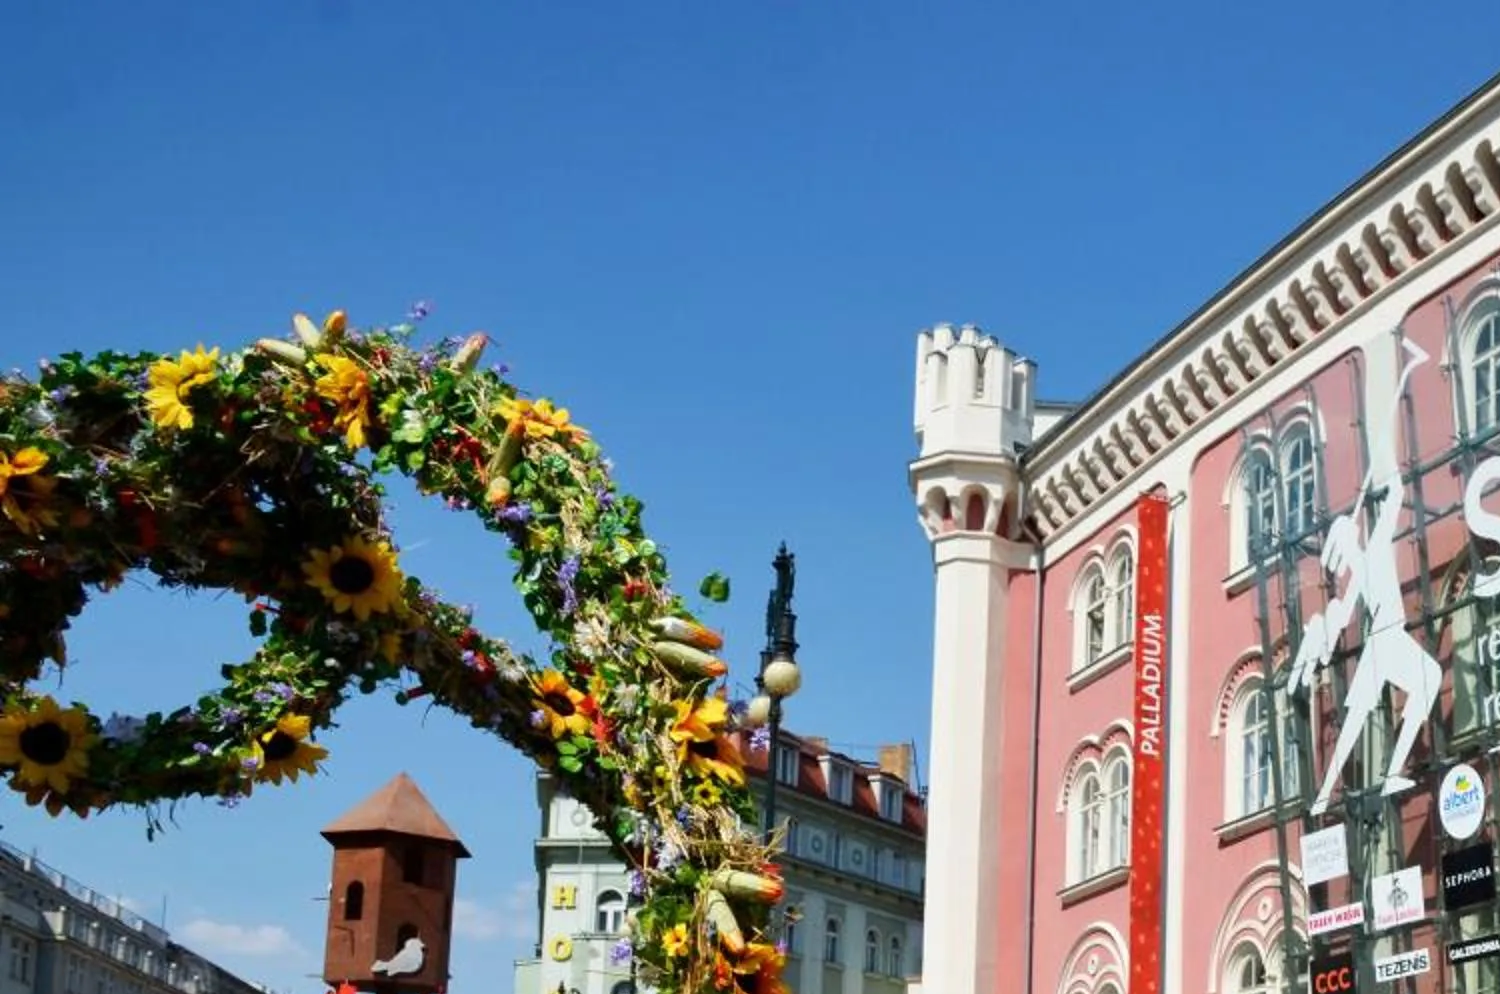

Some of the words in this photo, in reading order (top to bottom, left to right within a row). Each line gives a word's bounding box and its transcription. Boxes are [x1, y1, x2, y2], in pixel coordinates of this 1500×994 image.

[1139, 614, 1163, 756] PALLADIUM
[1443, 784, 1480, 811] albert
[1444, 865, 1492, 889] SEPHORA
[1377, 954, 1428, 979] TEZENIS
[1315, 967, 1352, 994] CCC
